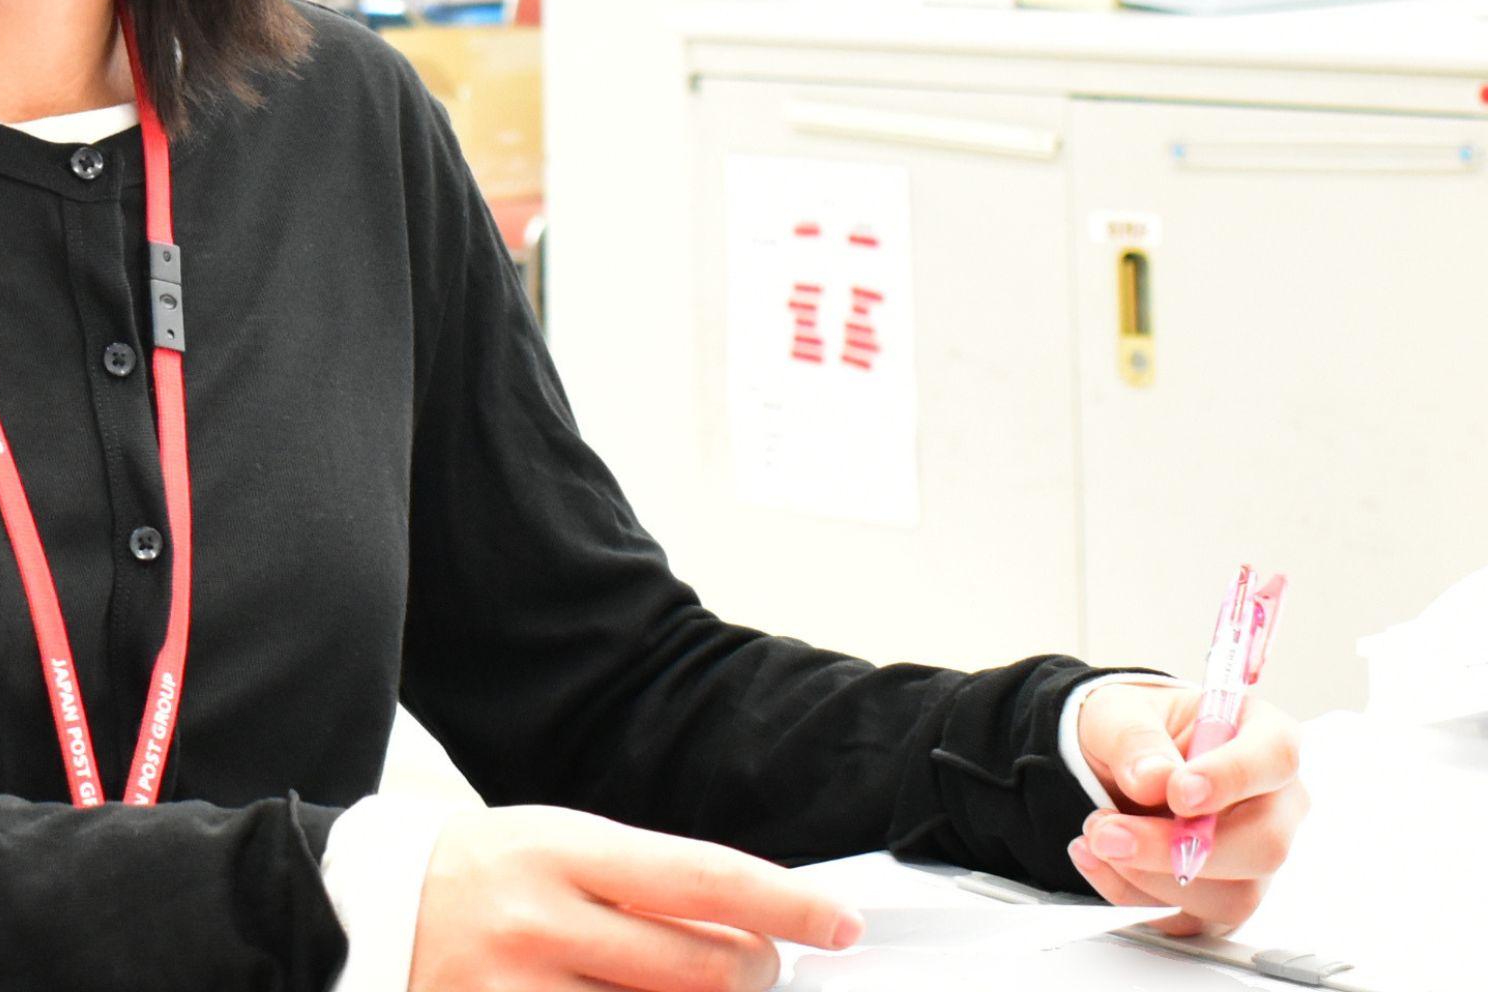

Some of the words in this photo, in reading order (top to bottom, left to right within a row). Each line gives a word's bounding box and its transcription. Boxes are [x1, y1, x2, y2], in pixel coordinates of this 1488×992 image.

[52, 658, 80, 722] JAPAN
[67, 726, 92, 779] POST
[138, 739, 162, 792] POST
[152, 672, 176, 740] GROUP
